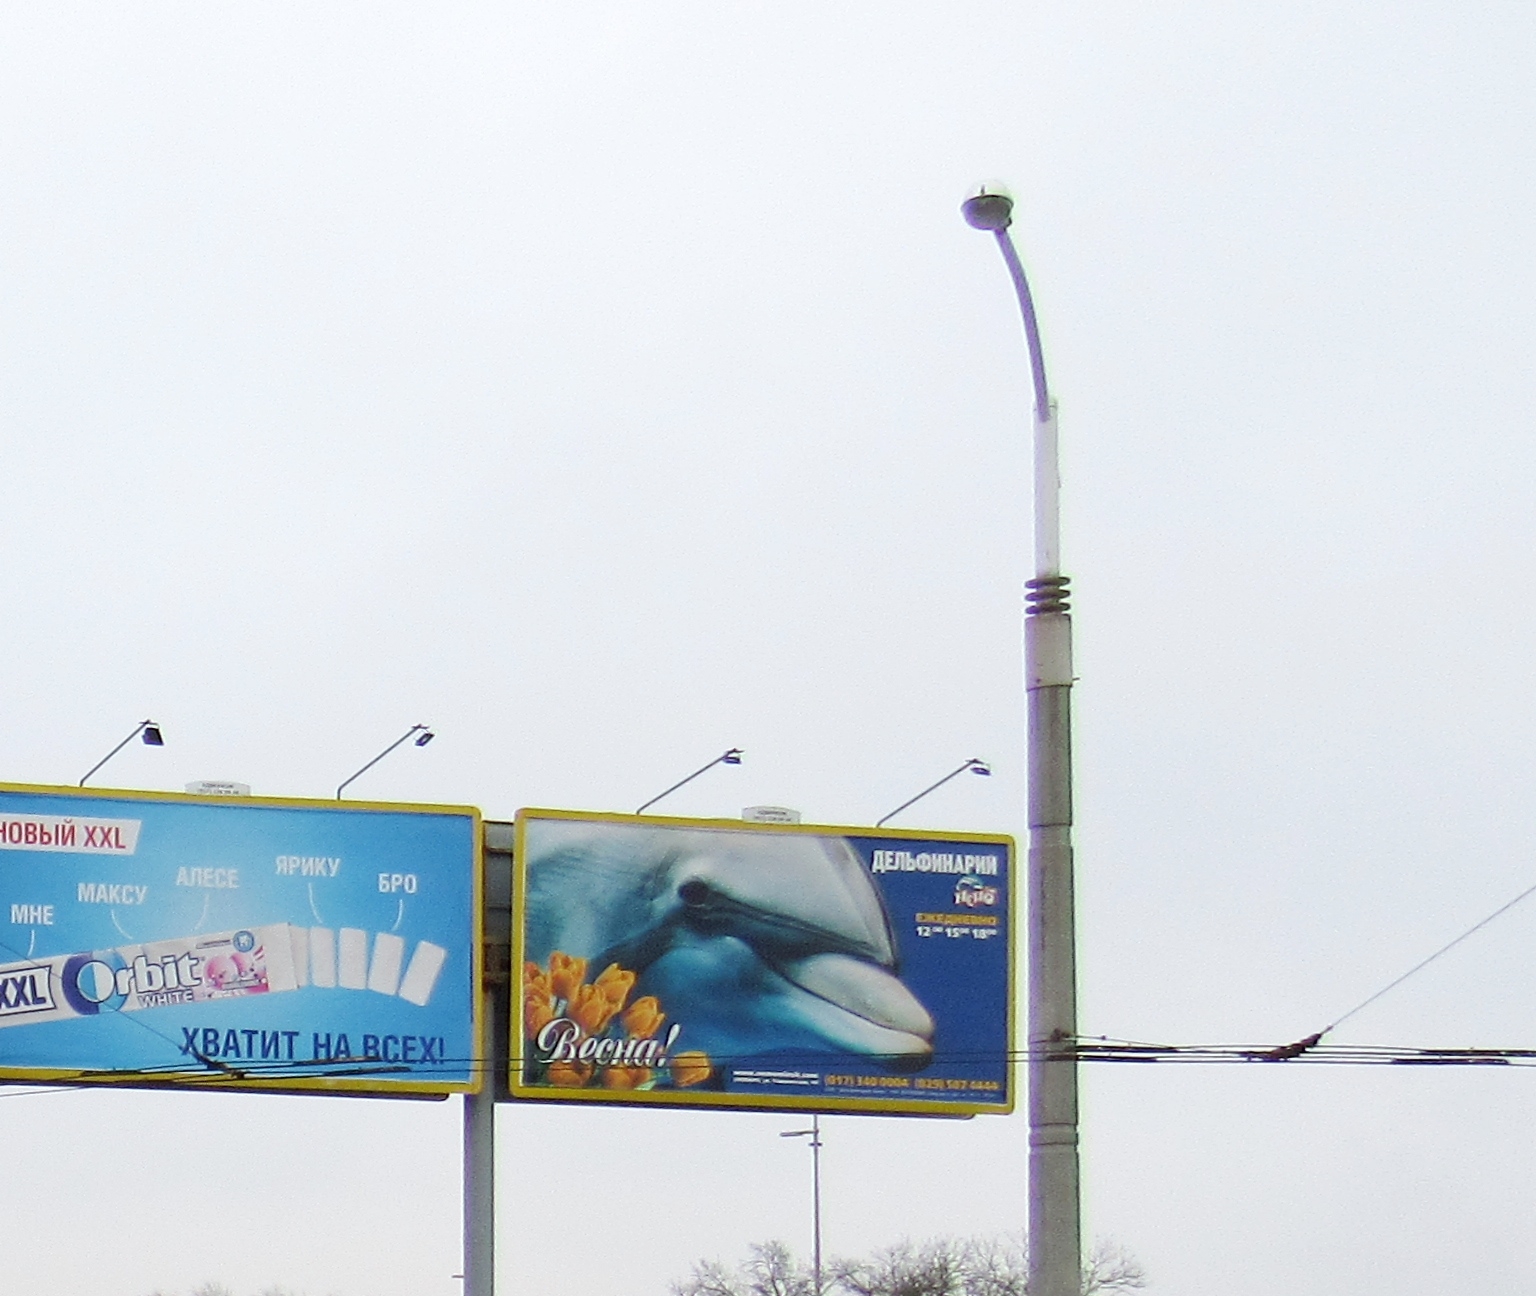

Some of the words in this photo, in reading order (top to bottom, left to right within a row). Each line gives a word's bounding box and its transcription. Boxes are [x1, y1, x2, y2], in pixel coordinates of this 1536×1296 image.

[83, 825, 127, 849] XXL
[176, 866, 240, 889] АЛЕСЕ
[275, 855, 342, 877] ЯРИКУ
[78, 882, 148, 906] МАКСУ
[378, 873, 418, 894] БРО
[11, 904, 54, 925] МНЕ
[915, 912, 998, 926] ЕЖЕДНЕВНО
[76, 951, 204, 1003] Orbit
[137, 989, 194, 1009] WHITE
[181, 1027, 300, 1060] ХВАТИТ
[312, 1032, 352, 1060] НА
[362, 1033, 446, 1065] ВСЕХ!
[536, 1017, 681, 1068] Весна!
